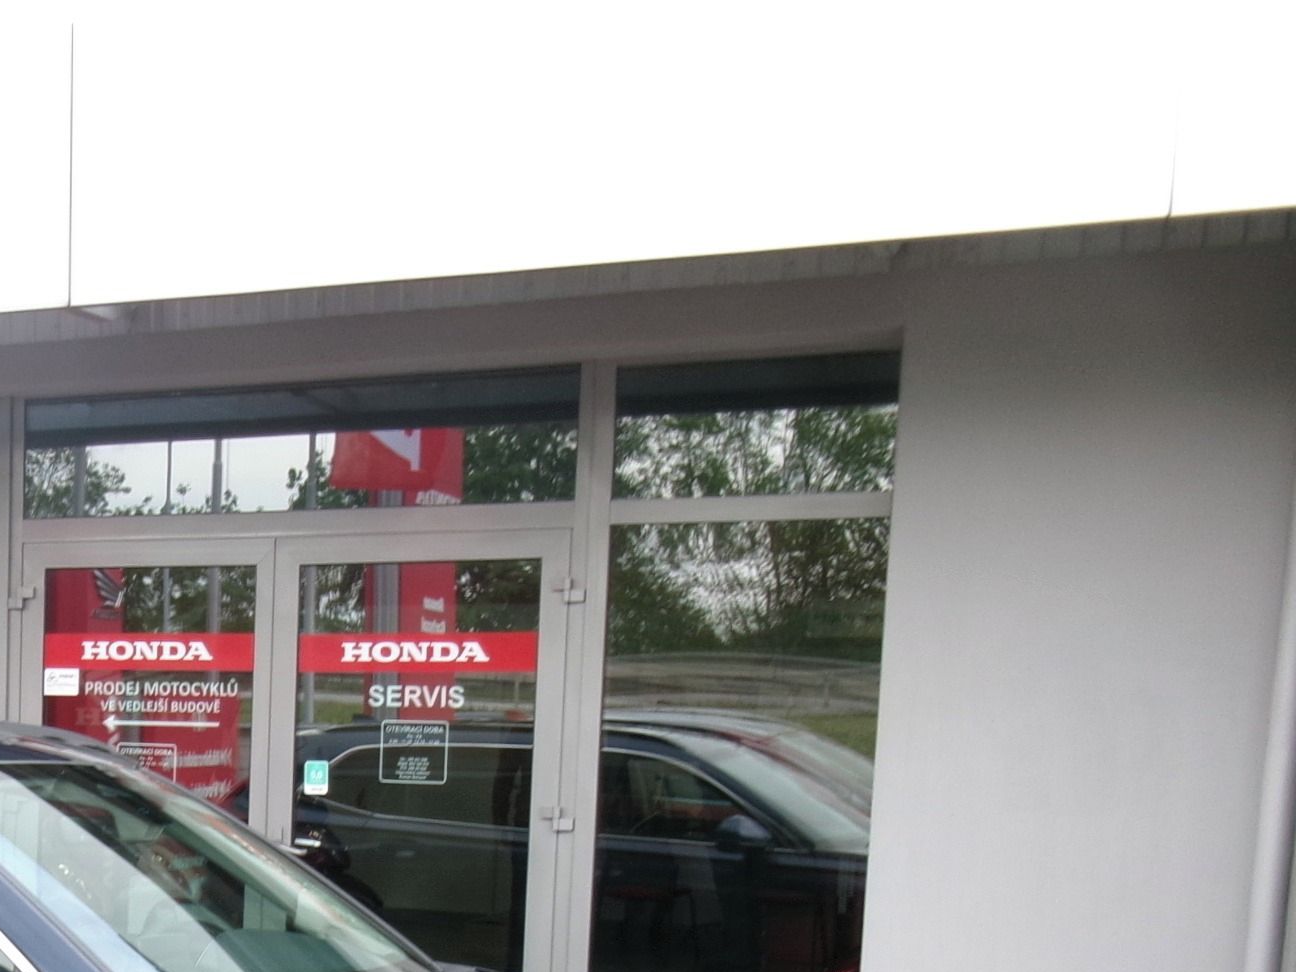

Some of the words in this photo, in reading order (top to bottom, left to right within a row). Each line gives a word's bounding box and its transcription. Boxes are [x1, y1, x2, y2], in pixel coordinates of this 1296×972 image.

[81, 640, 214, 661] HONDA
[340, 640, 490, 664] HONDA
[84, 680, 140, 697] PRODEJ
[143, 677, 239, 698] MOTOCYKLŮ
[367, 684, 466, 710] SERVIS
[100, 700, 116, 713] VE
[117, 698, 168, 713] VEDLEJŠÍ
[170, 699, 221, 714] BUDOVĚ
